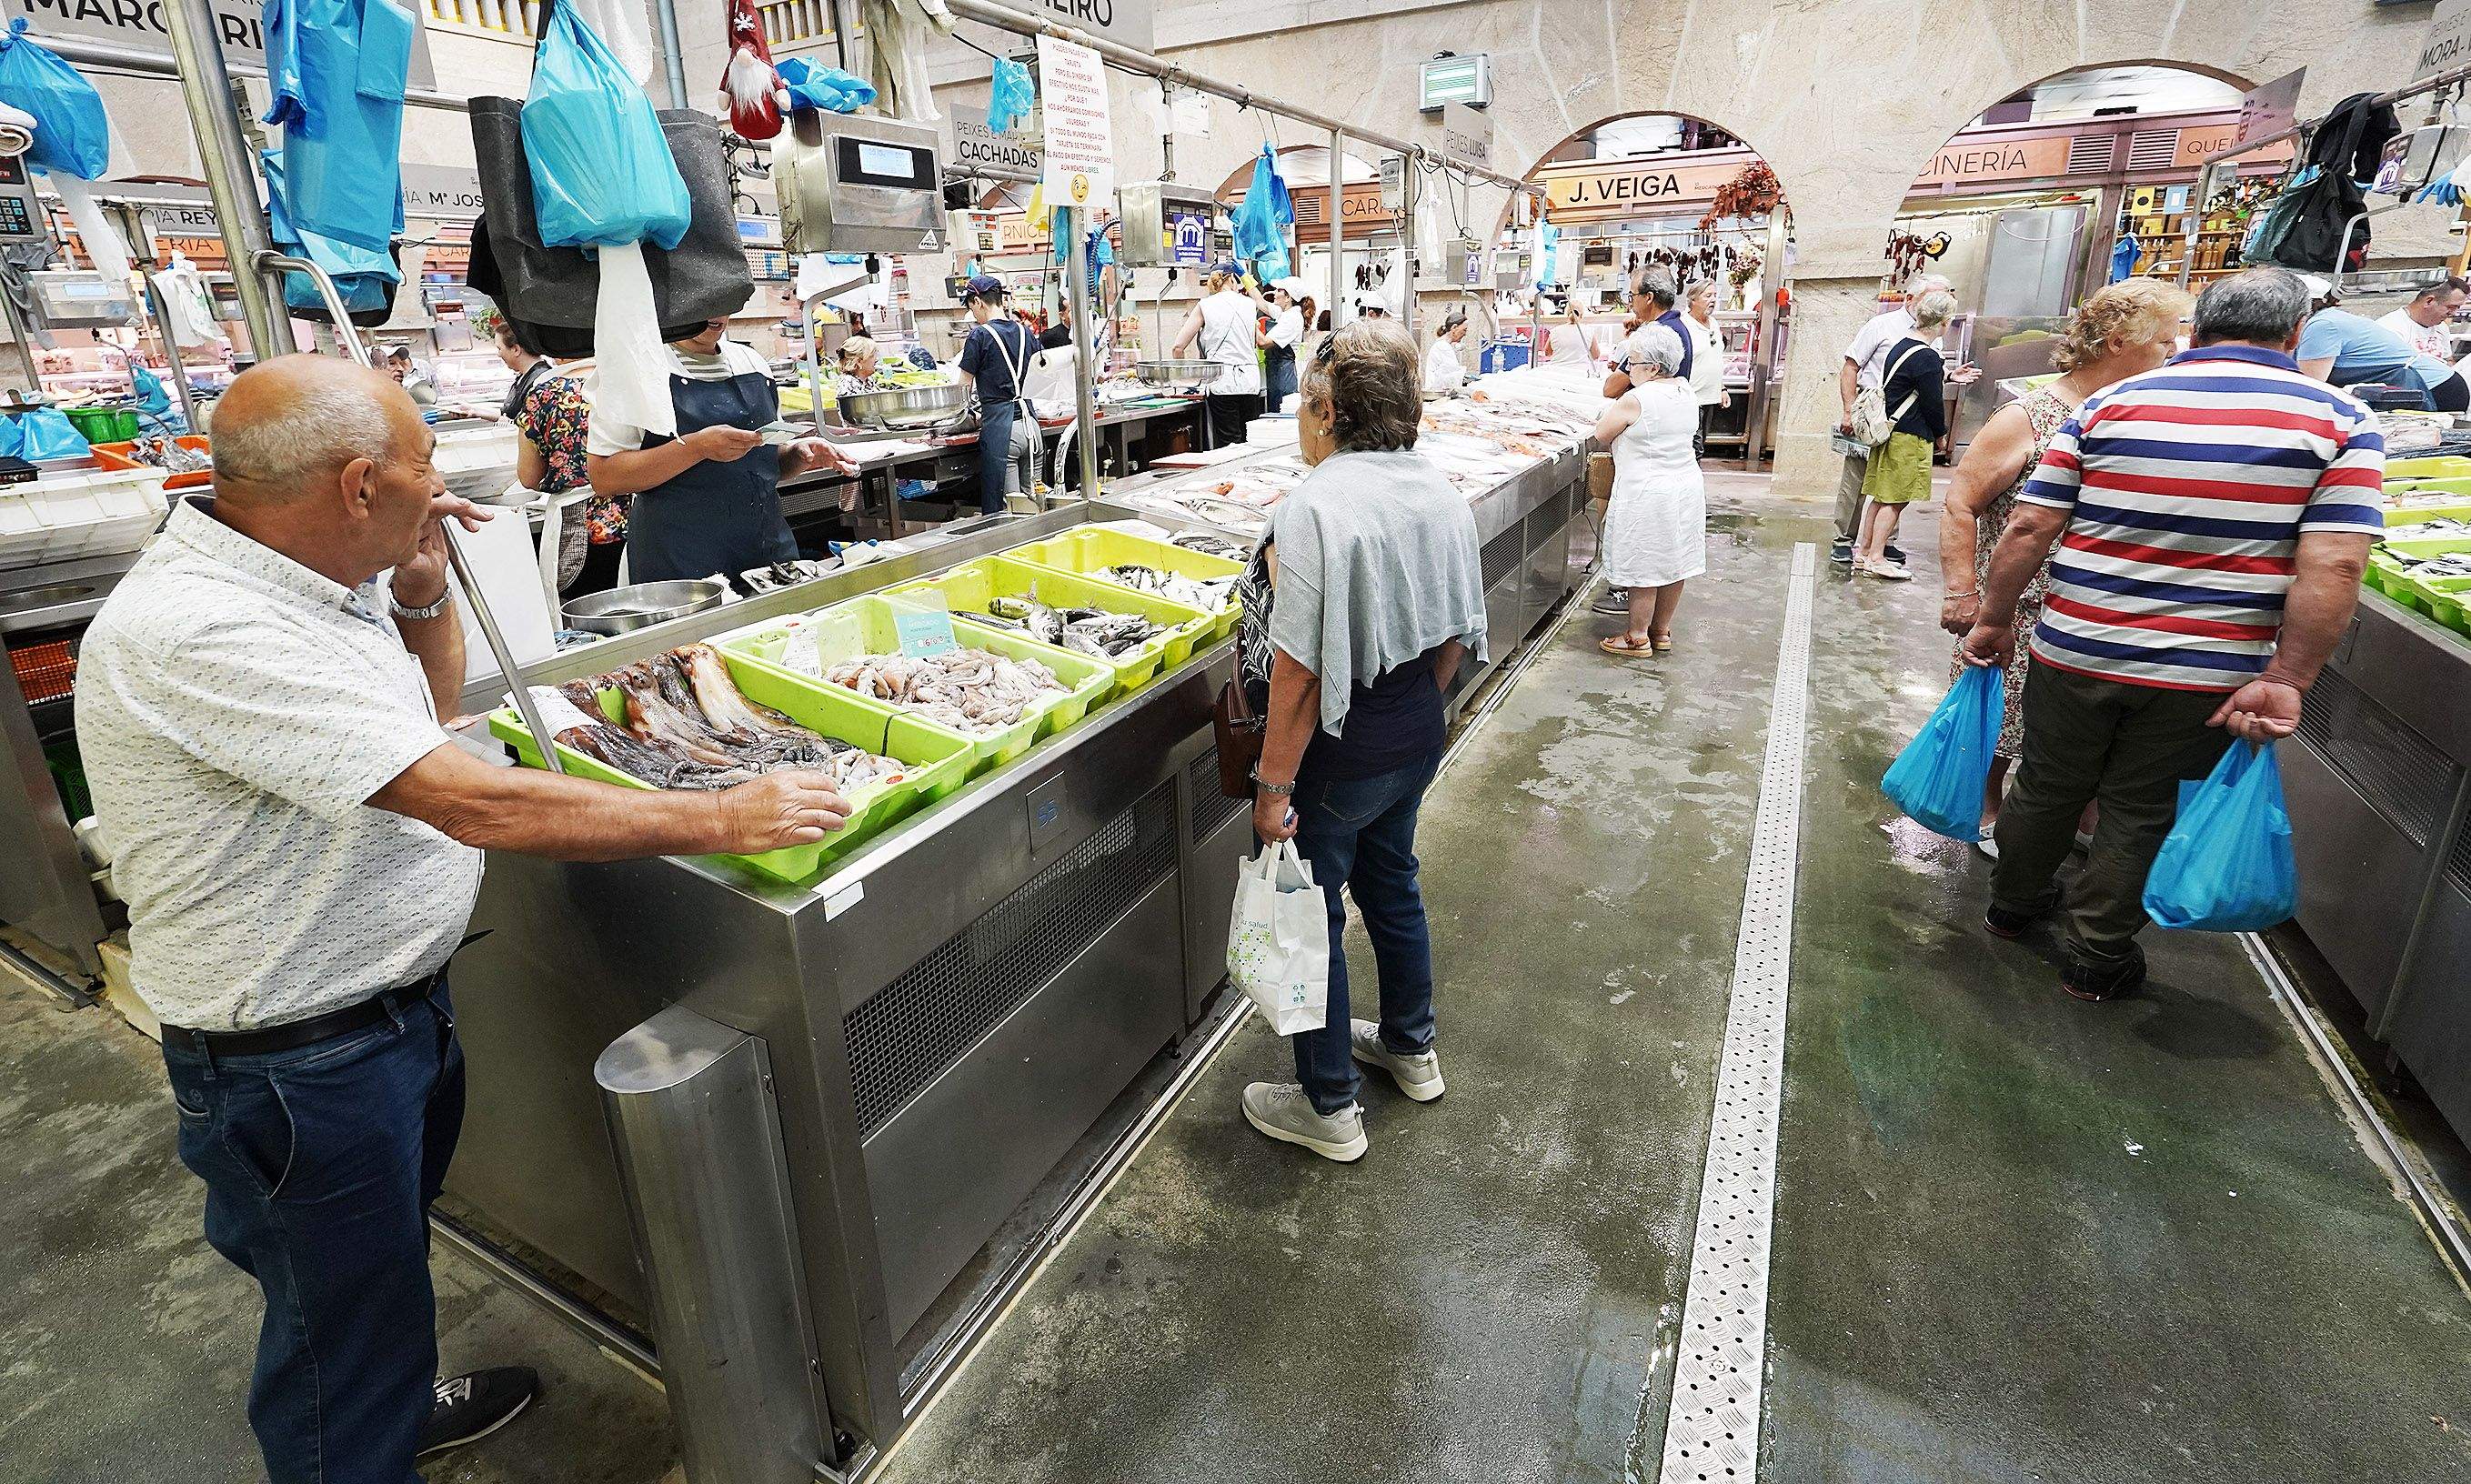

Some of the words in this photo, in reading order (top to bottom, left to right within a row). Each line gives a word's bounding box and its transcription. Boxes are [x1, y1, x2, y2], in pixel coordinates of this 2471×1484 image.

[959, 140, 1039, 169] CACHADAS
[1569, 181, 1590, 203] J.
[1596, 174, 1681, 200] VEIGA
